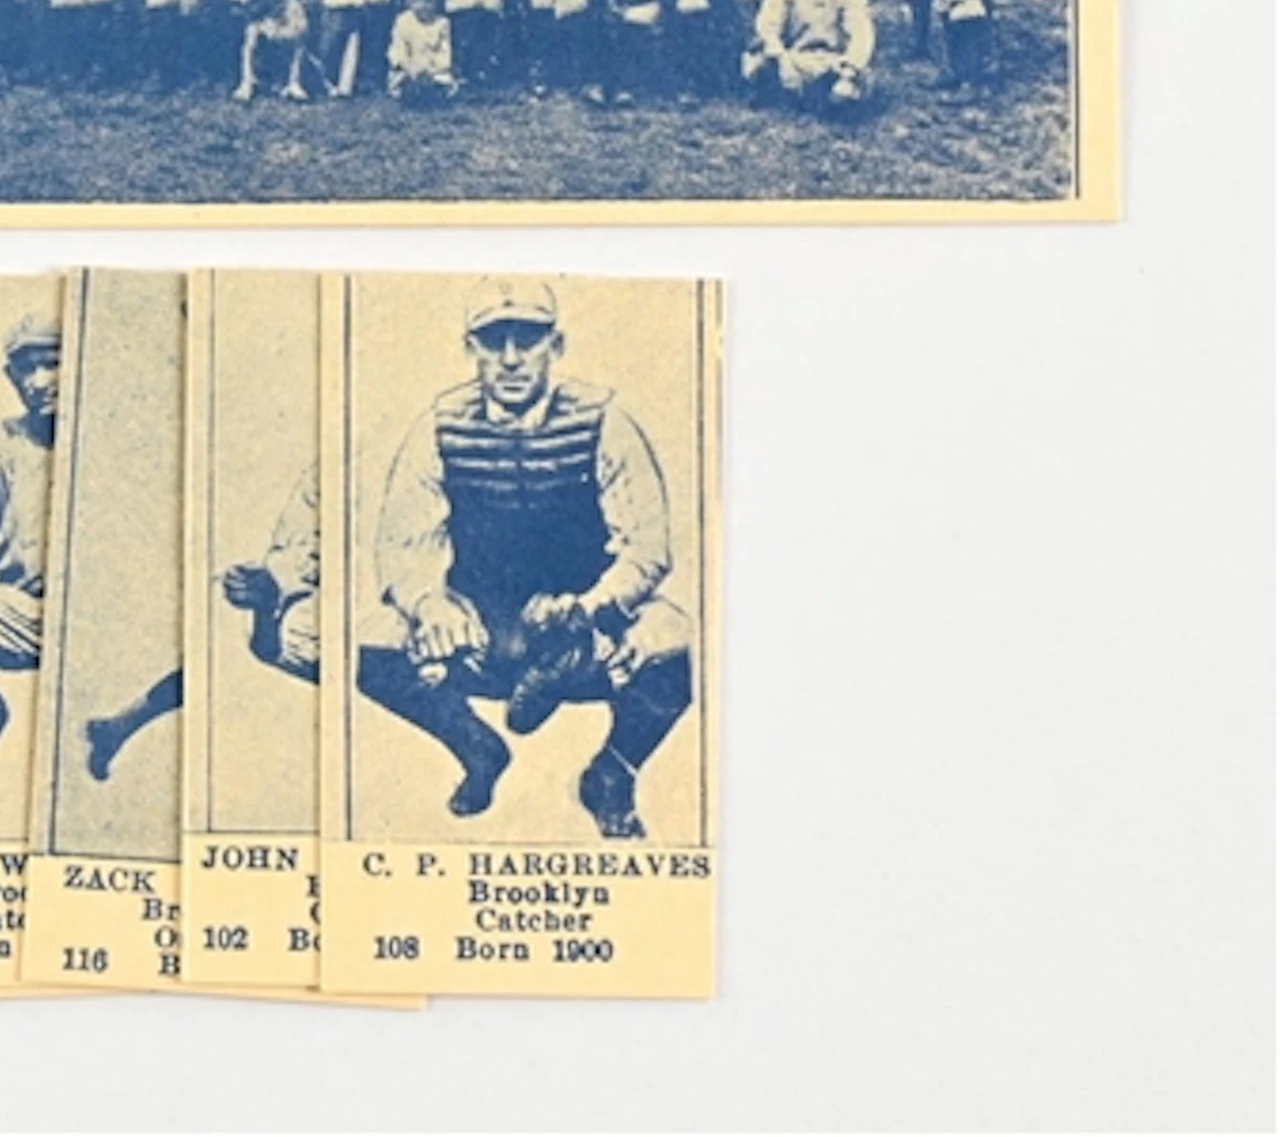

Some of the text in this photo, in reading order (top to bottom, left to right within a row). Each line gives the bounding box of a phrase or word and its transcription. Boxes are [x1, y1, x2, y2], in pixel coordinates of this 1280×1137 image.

[200, 845, 299, 872] JOHN
[361, 852, 712, 880] C. P. HARGREAVES
[63, 864, 156, 895] ZACK
[467, 878, 610, 910] Brooklyn
[474, 907, 594, 933] Catcher
[203, 925, 249, 951] 102
[373, 935, 614, 963] 108 Born 1900
[62, 947, 109, 974] 116
